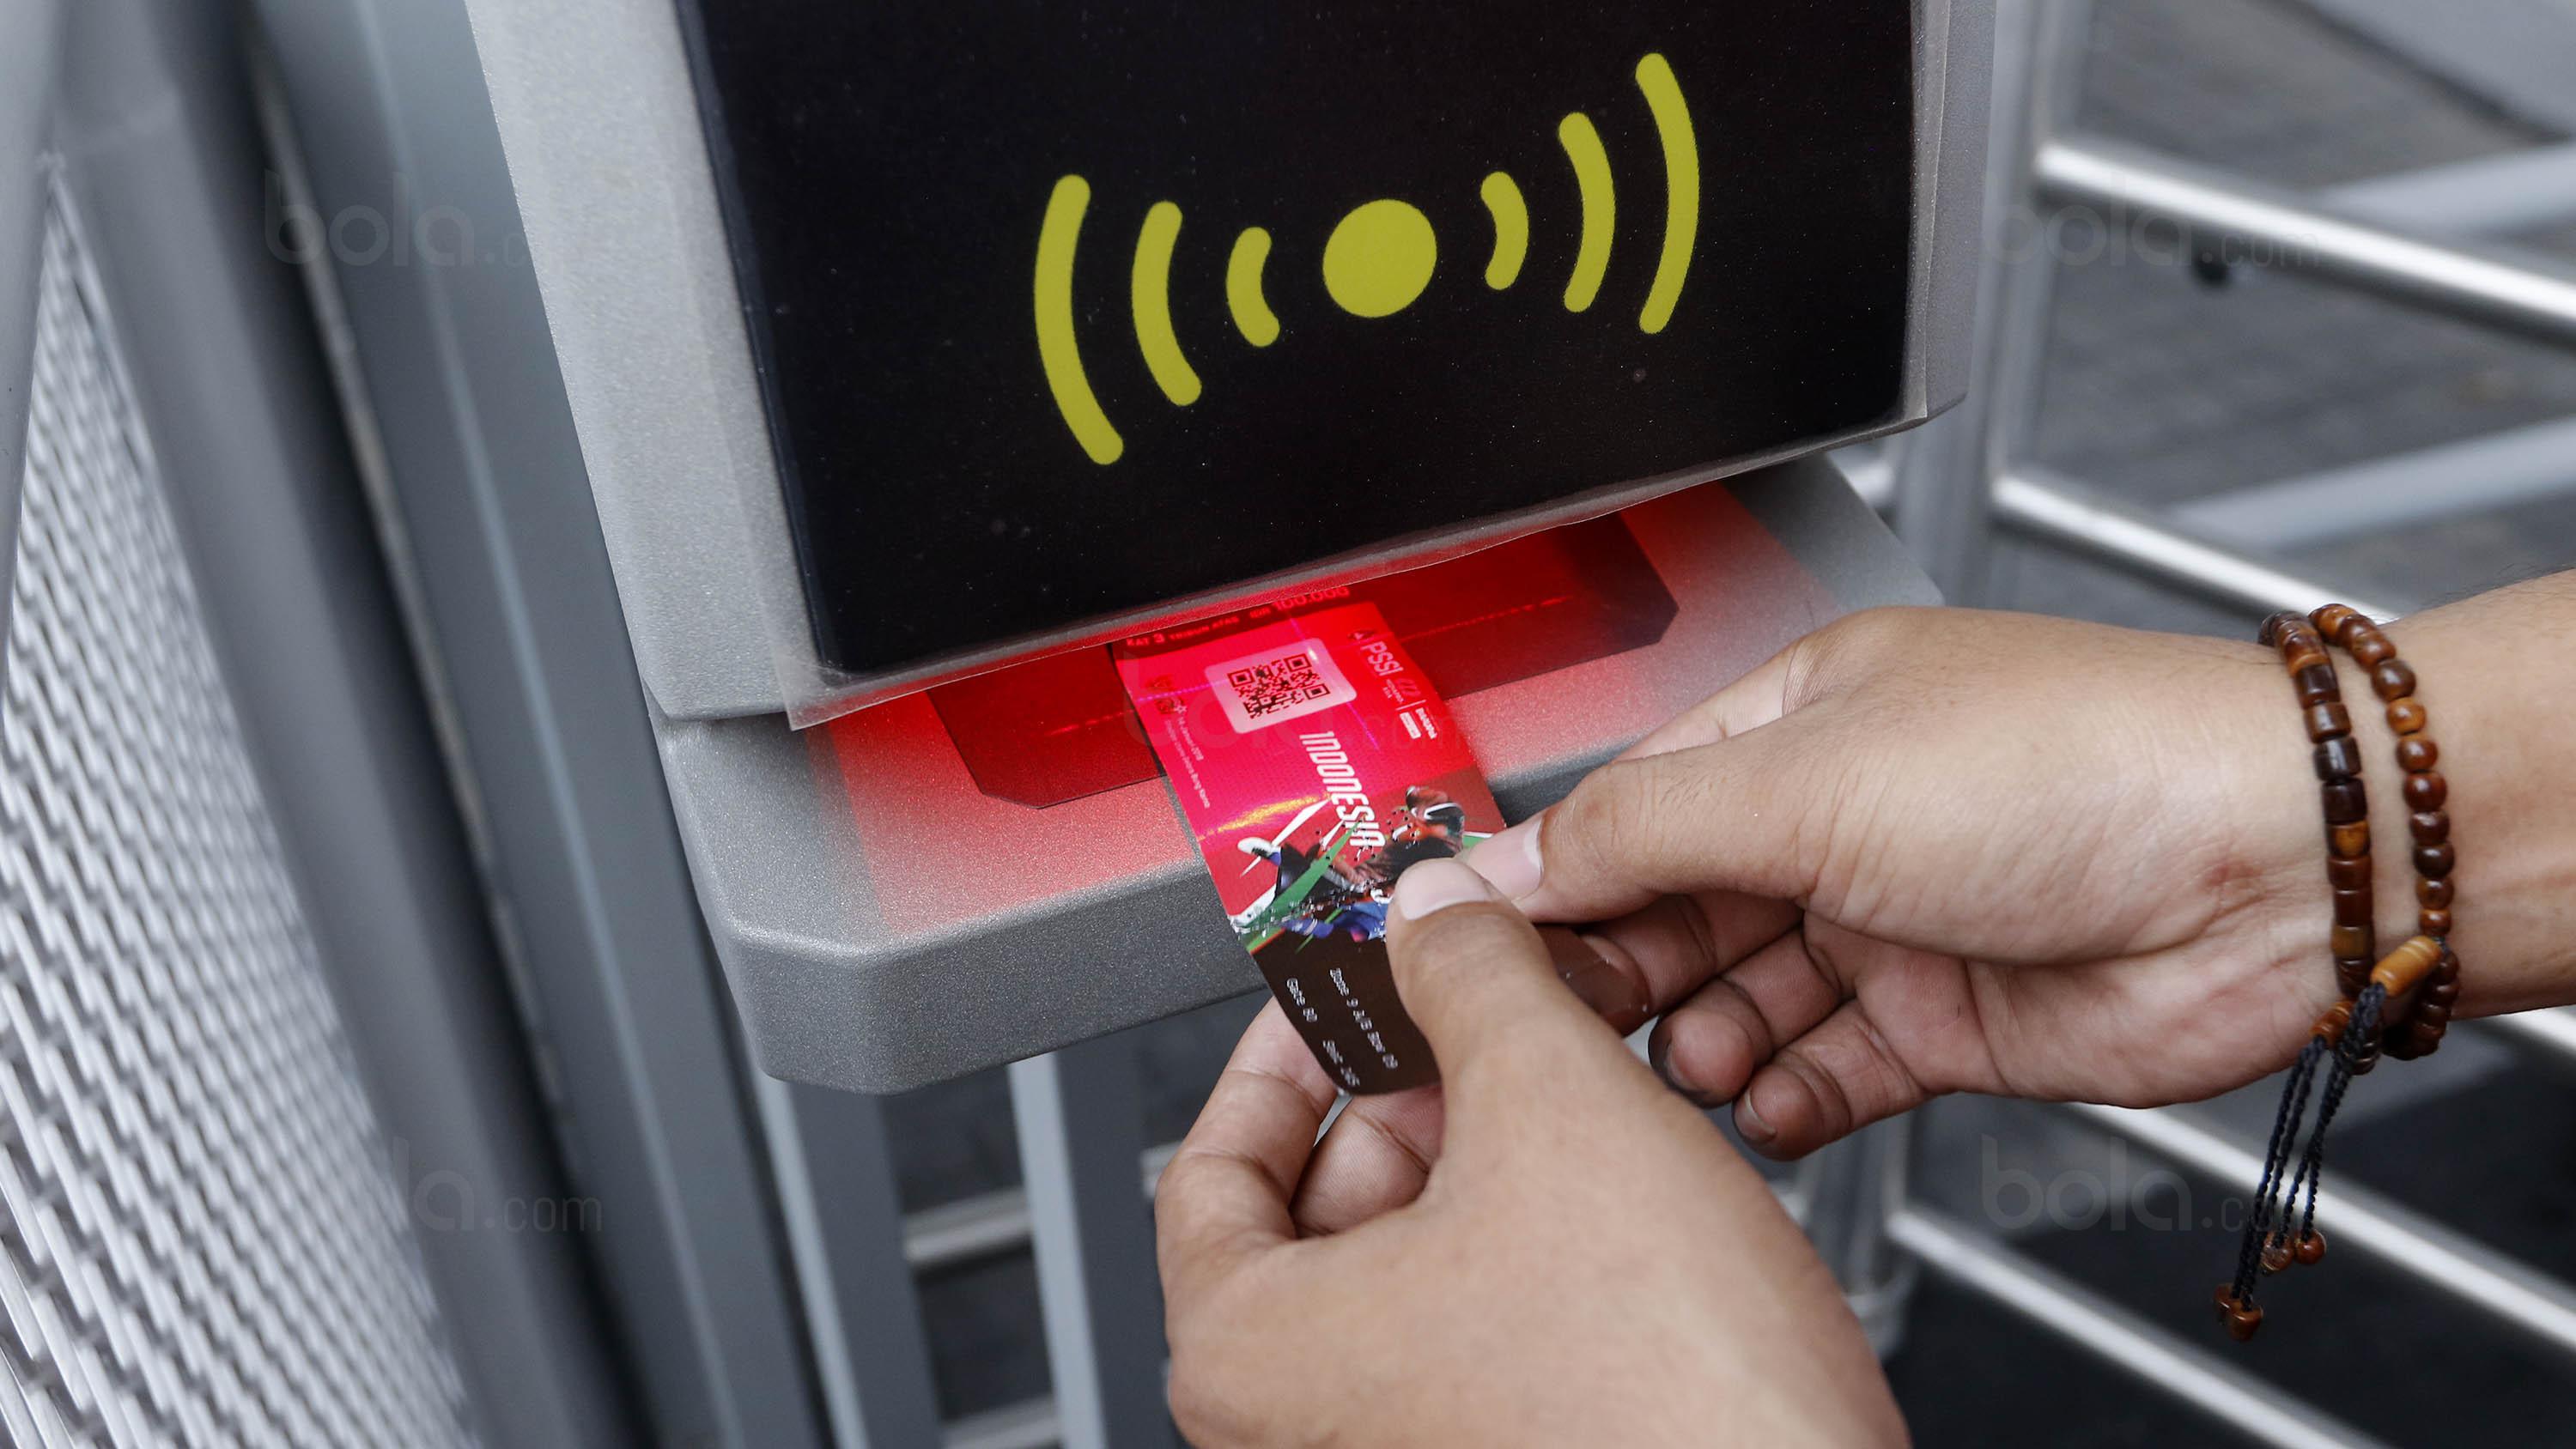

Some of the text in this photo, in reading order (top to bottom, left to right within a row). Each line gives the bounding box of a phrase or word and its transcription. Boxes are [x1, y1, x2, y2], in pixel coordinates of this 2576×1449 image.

[1152, 634, 1166, 645] 3
[1360, 640, 1404, 676] PSSI
[1299, 731, 1386, 846] INDONESIA
